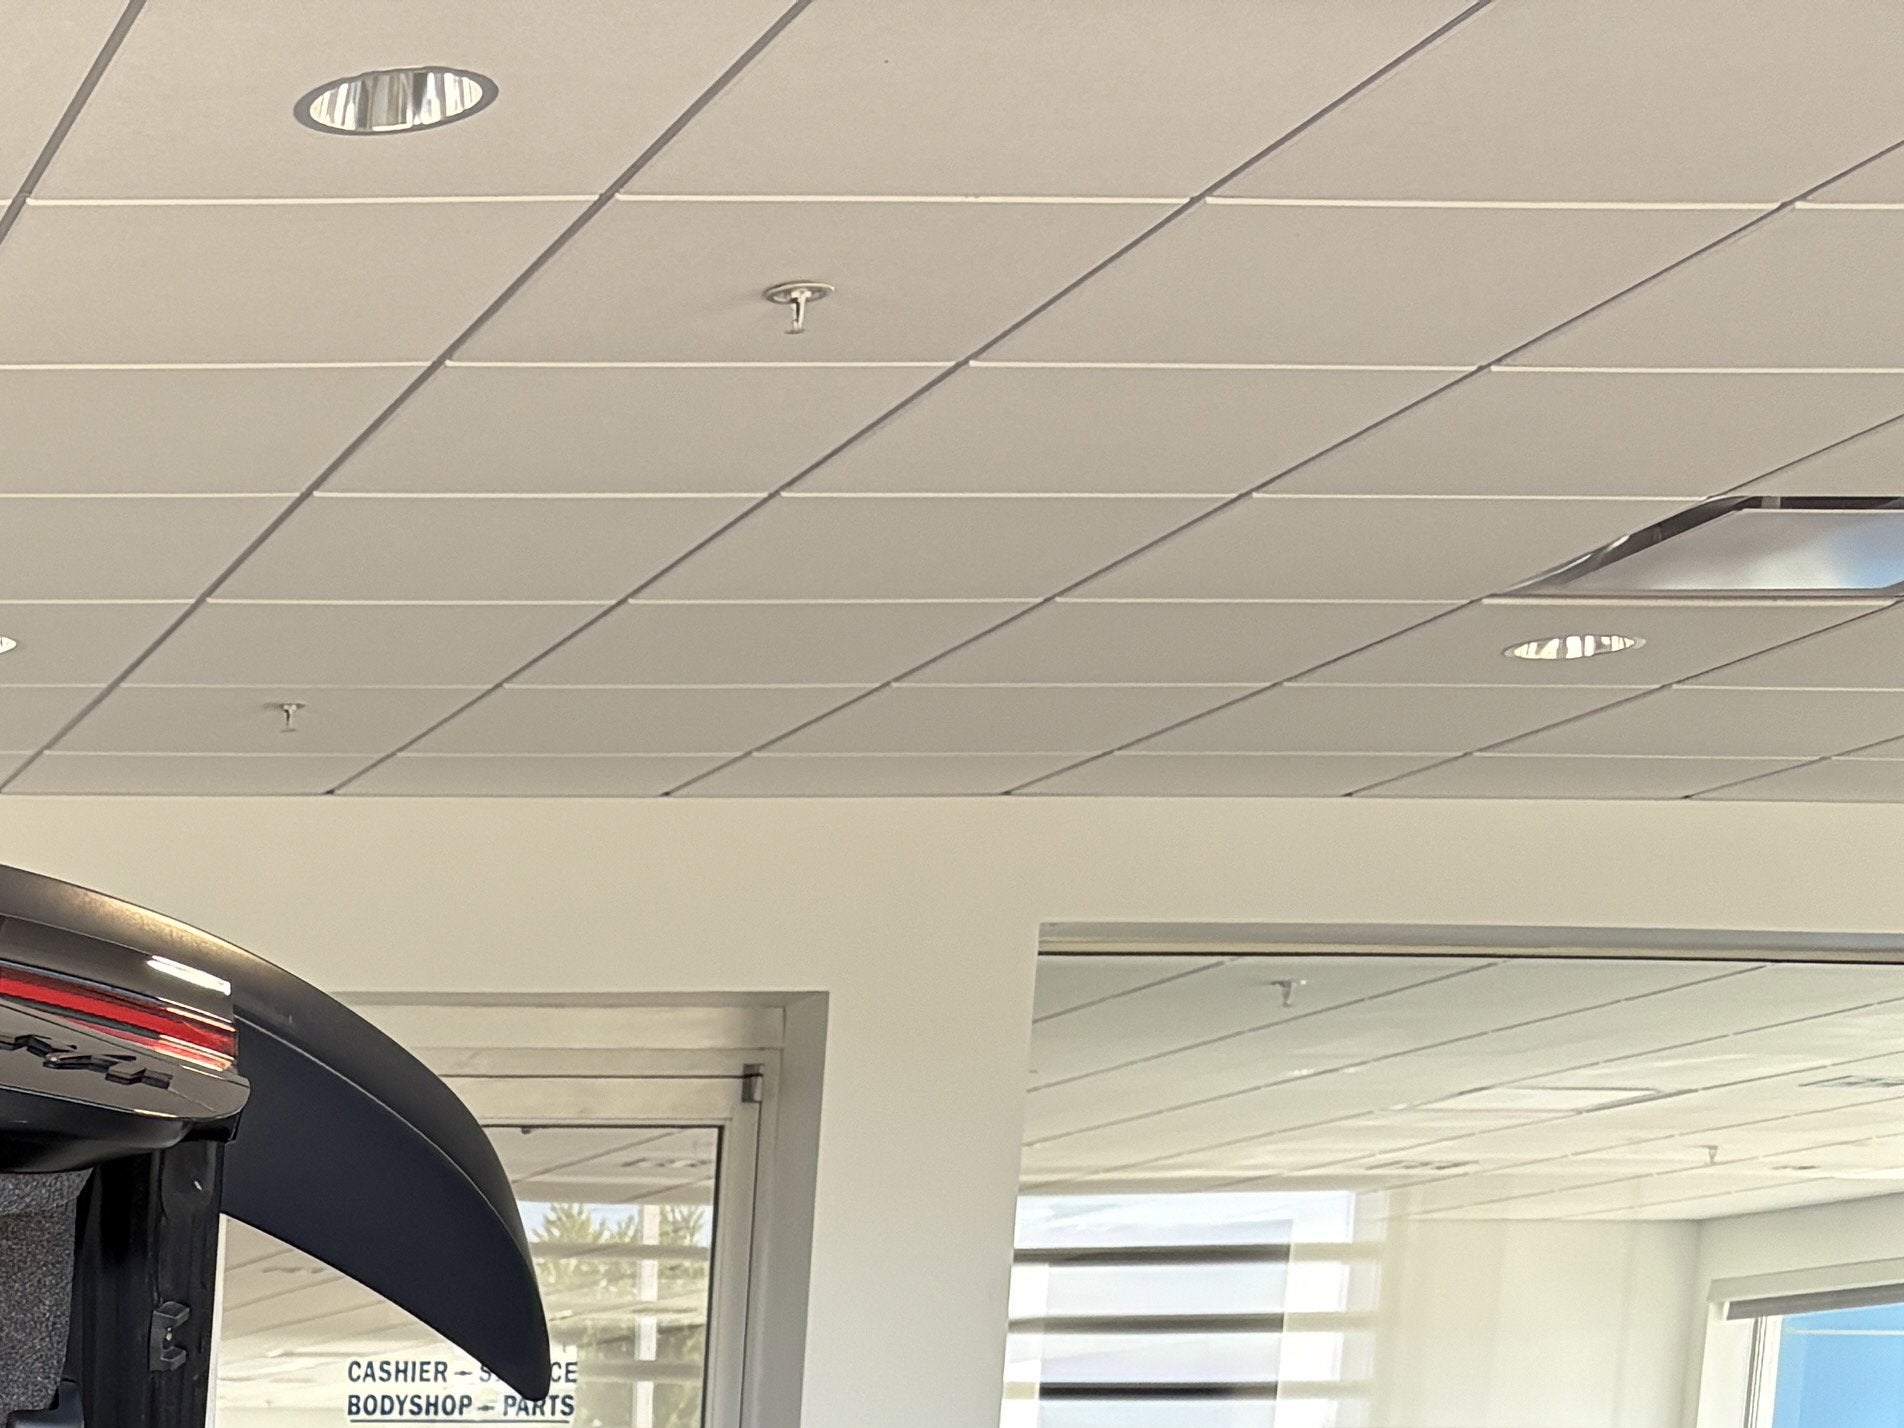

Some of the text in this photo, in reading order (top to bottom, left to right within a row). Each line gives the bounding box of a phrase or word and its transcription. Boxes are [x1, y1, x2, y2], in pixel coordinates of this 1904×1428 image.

[348, 1361, 448, 1383] CASHIER
[348, 1394, 574, 1416] BODYSHOP PARTS
